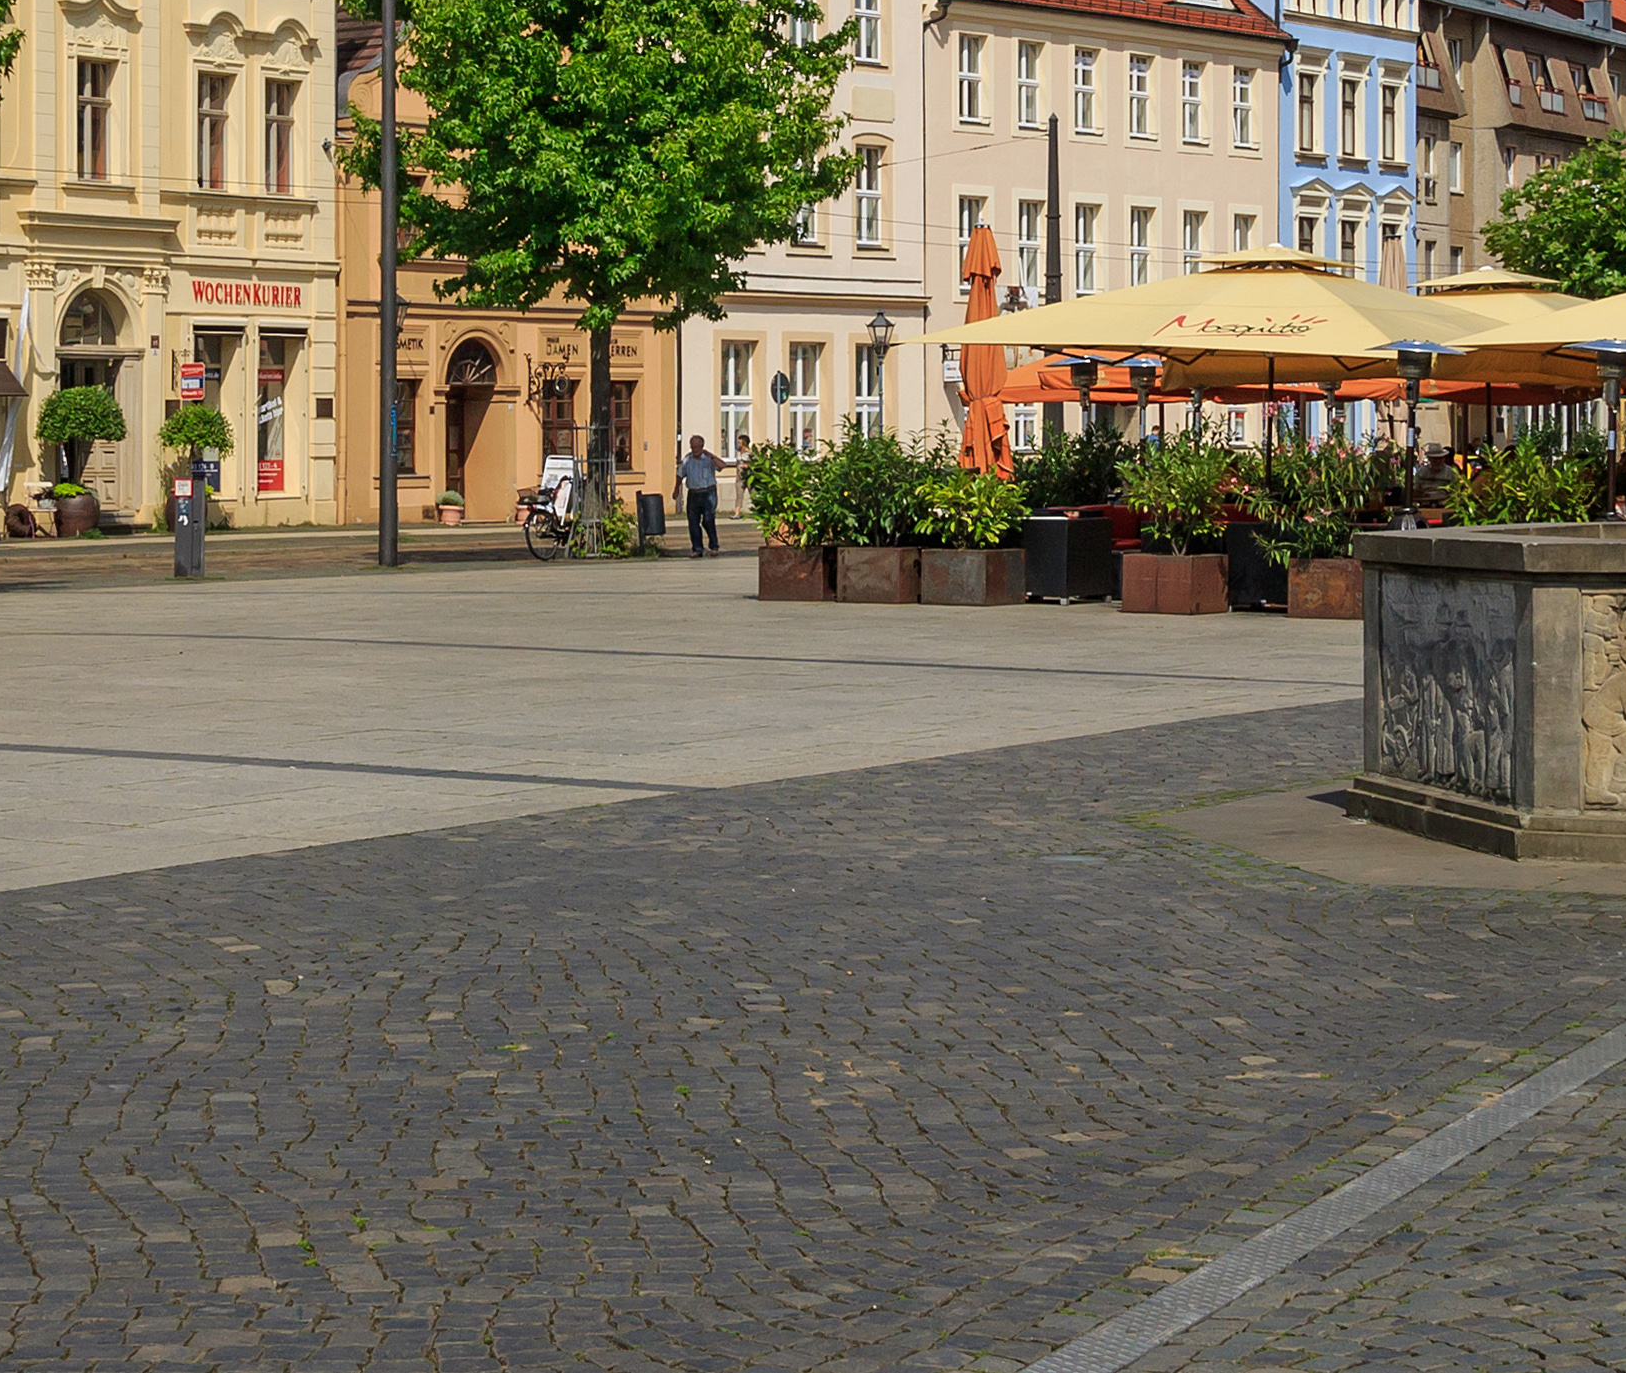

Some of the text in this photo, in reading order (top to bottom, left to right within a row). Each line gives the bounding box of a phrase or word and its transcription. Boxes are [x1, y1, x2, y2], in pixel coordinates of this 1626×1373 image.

[1153, 314, 1313, 338] Mosquito
[546, 343, 579, 356] DAMEN
[611, 345, 638, 357] ERREN
